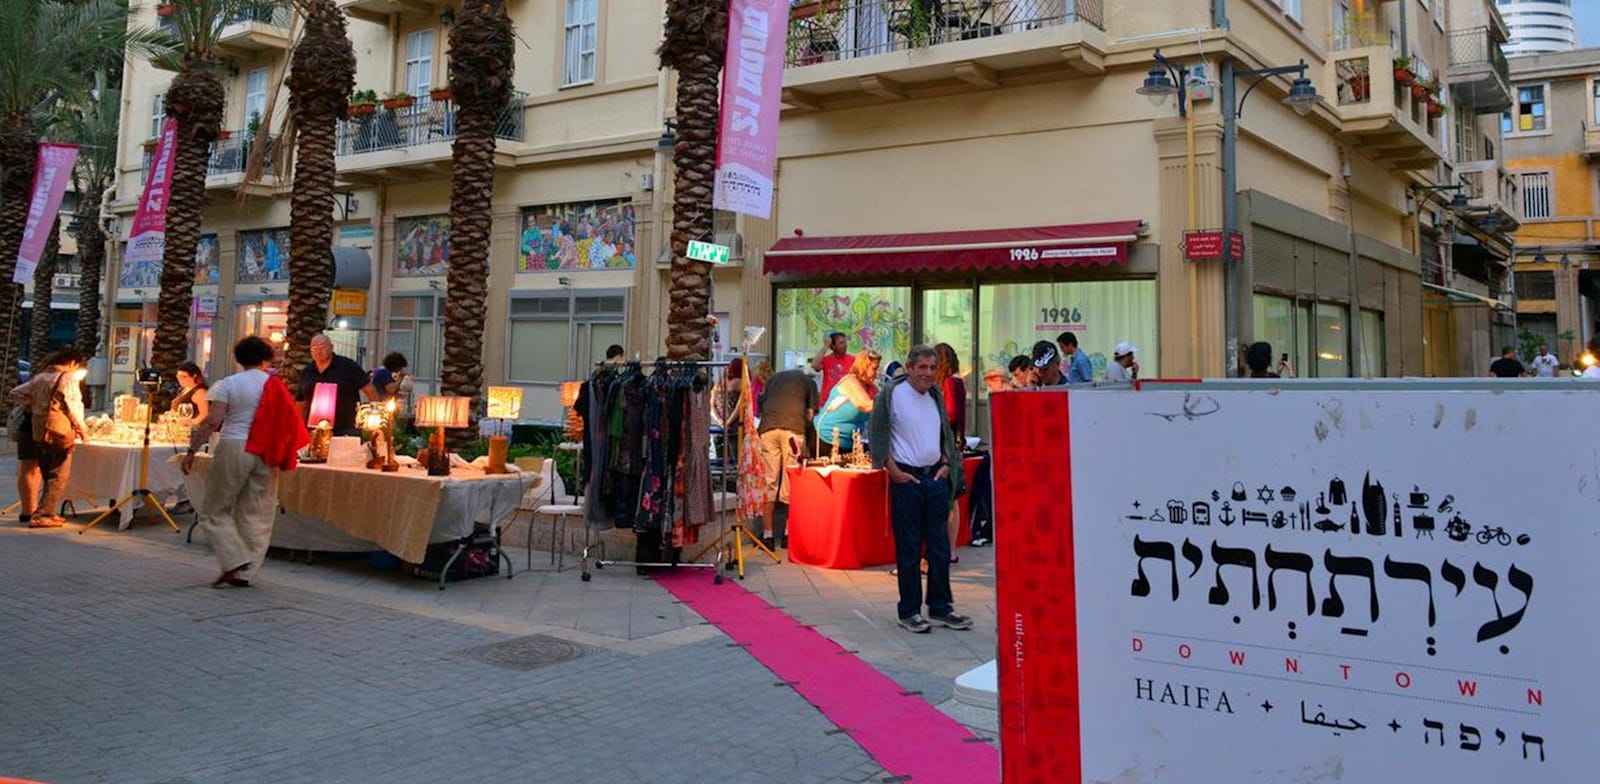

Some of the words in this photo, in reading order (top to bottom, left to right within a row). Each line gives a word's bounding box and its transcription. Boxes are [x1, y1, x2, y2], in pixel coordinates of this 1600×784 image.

[1009, 248, 1039, 261] 1926
[1041, 307, 1082, 323] 1926
[1135, 677, 1235, 714] HAIFA
[1300, 700, 1367, 737] حيفا
[1423, 717, 1546, 763] חיפה
